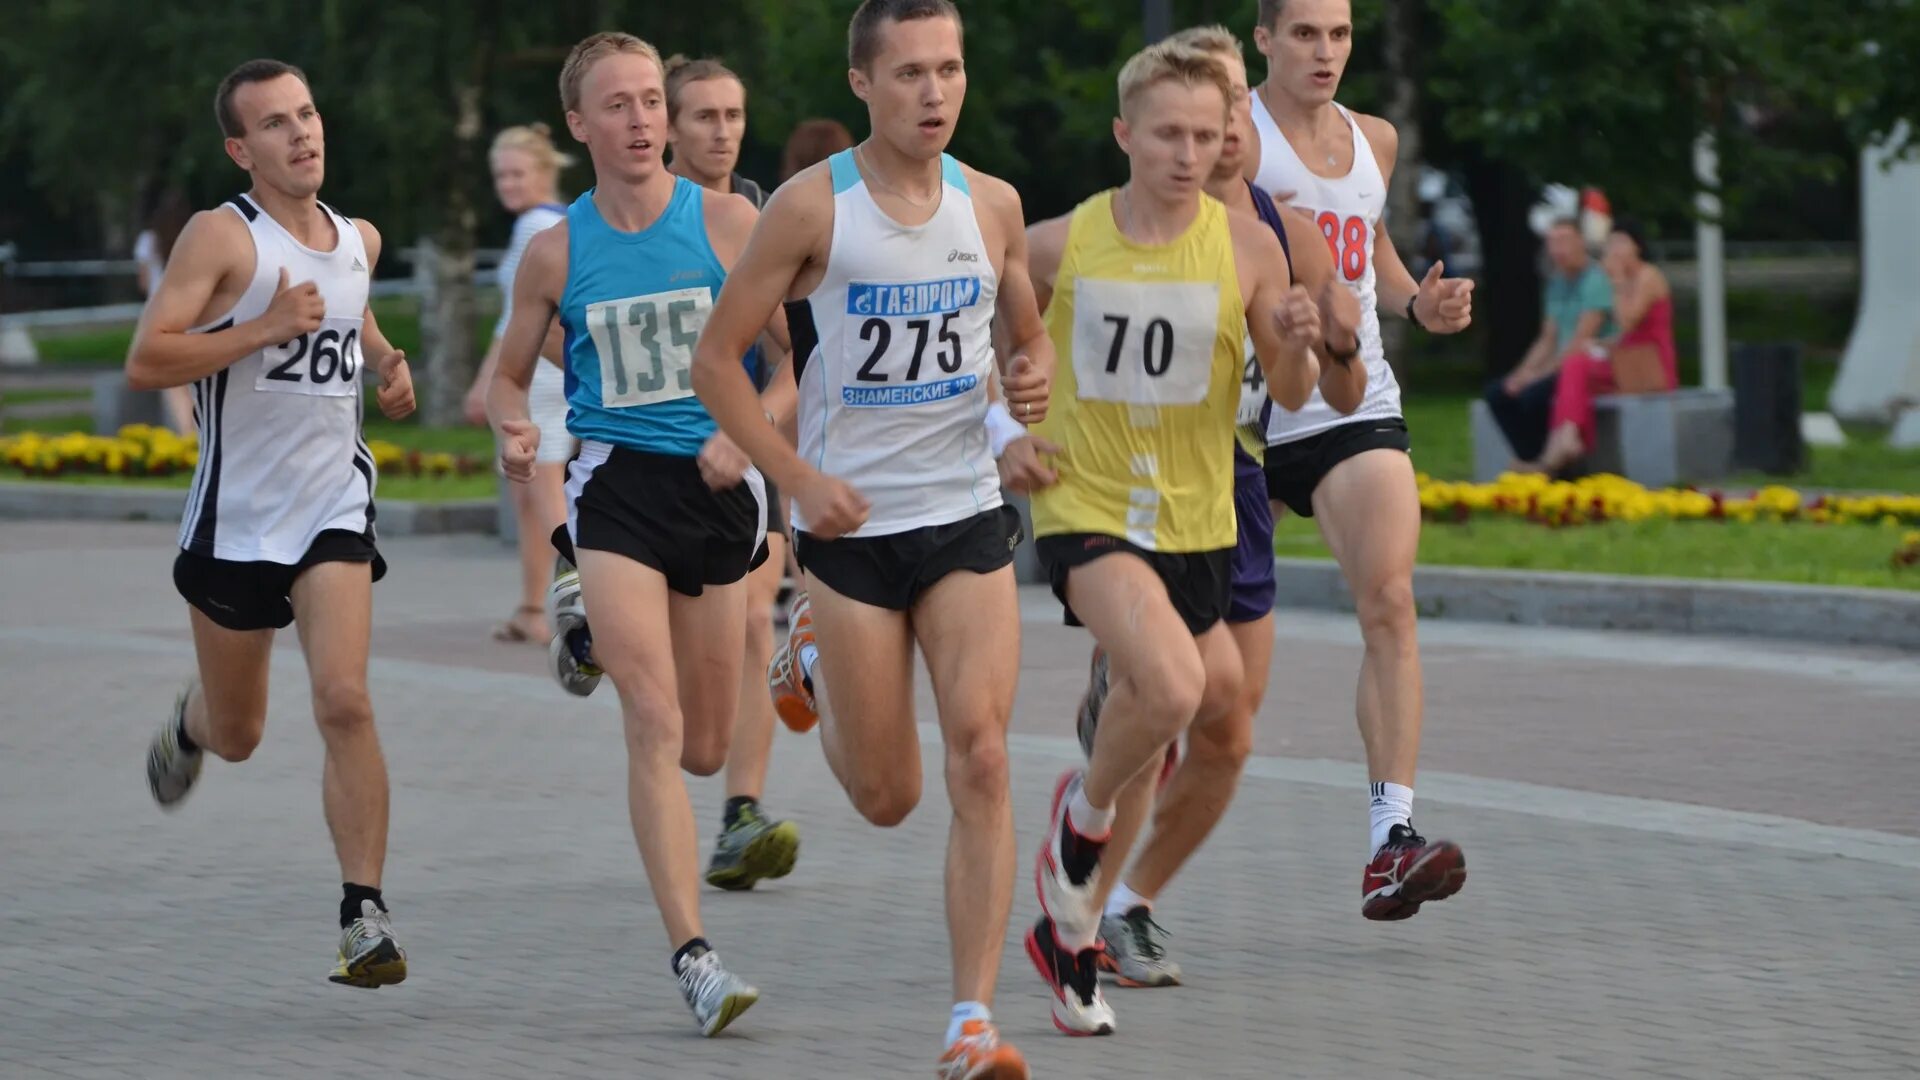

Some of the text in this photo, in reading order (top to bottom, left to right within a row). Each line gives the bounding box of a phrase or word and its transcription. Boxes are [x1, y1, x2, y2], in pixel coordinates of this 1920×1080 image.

[875, 278, 975, 315] ГАЗПРОМ
[265, 328, 357, 384] 260
[604, 300, 698, 396] 135
[856, 310, 963, 382] 275
[1103, 313, 1174, 377] 70
[844, 381, 951, 404] ЗНАМЕНСКИЕ
